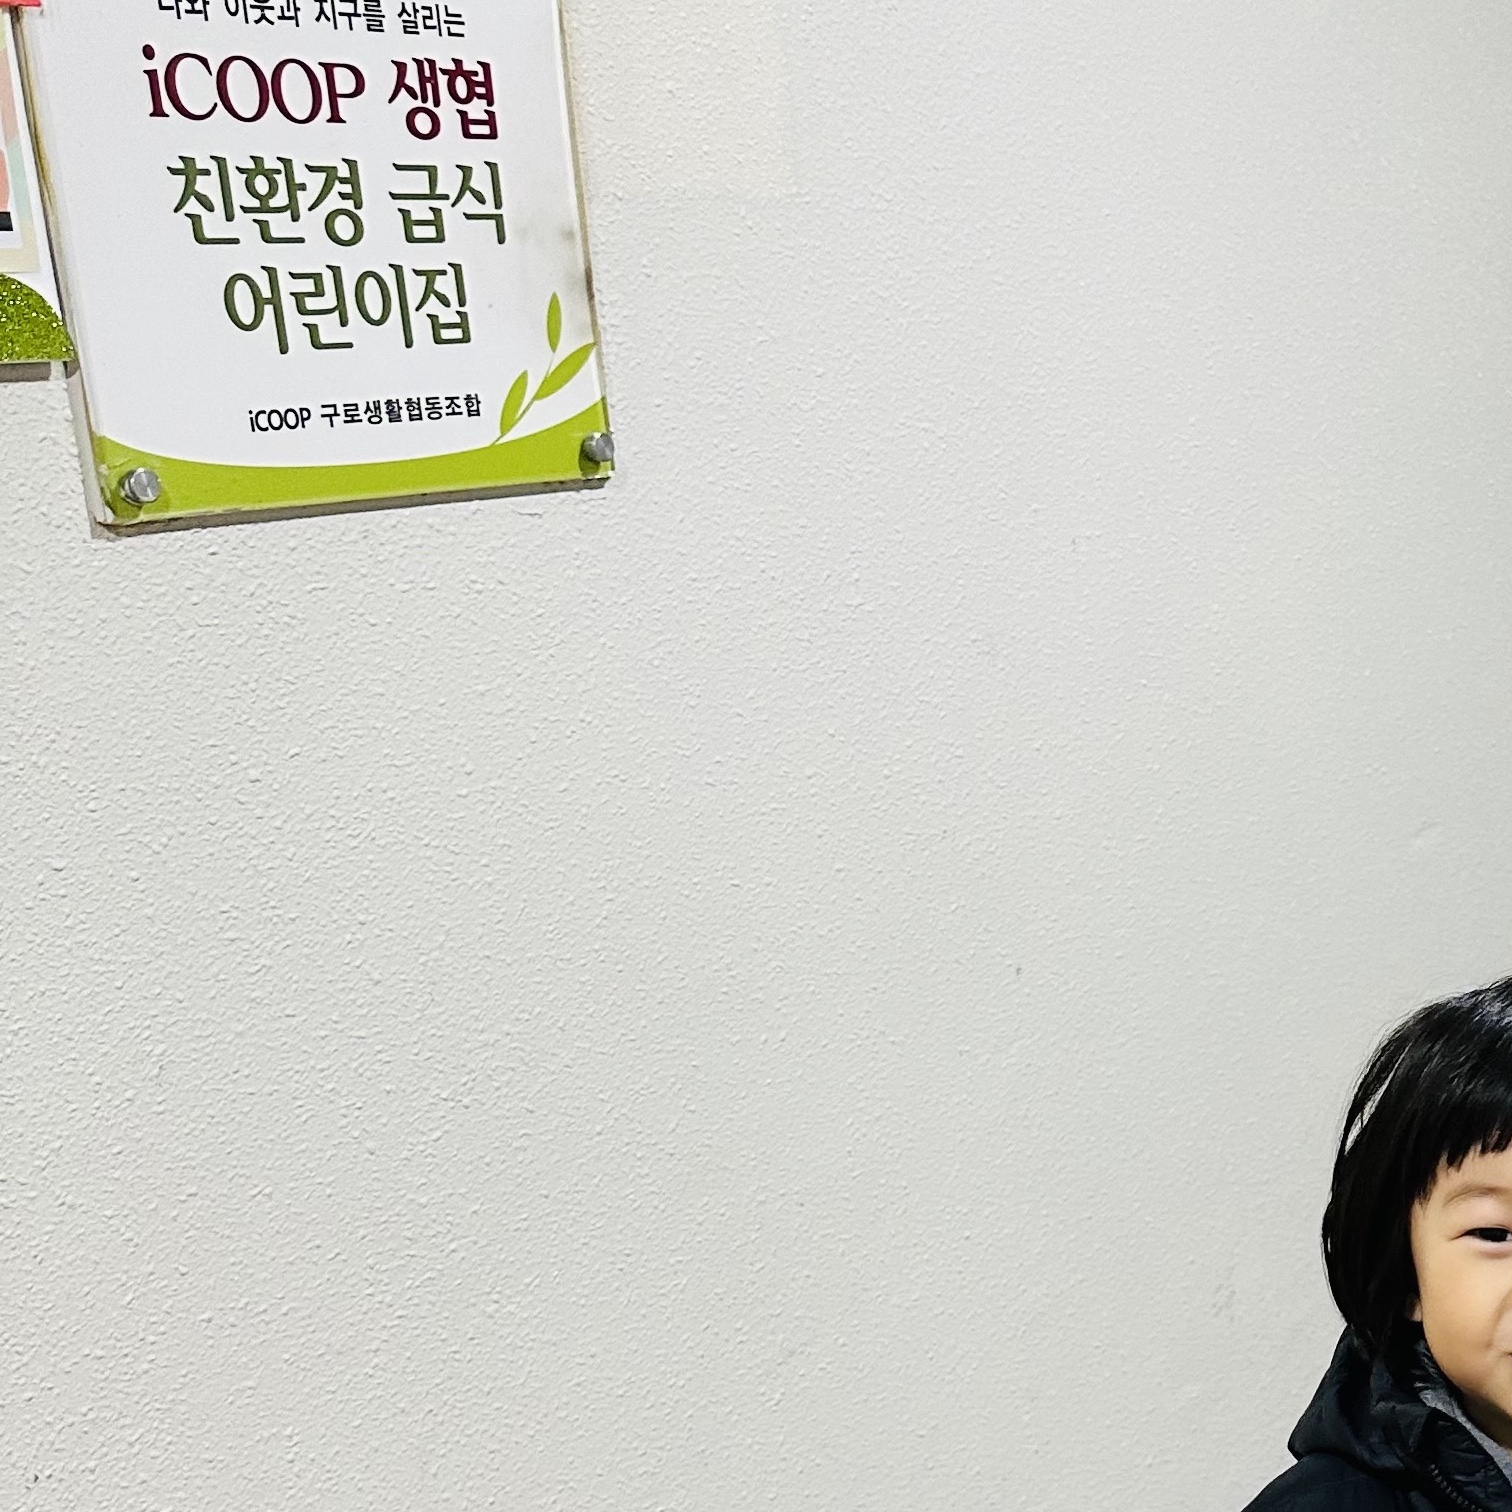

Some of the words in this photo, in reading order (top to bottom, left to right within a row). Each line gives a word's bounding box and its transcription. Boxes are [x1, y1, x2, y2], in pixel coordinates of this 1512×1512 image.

[314, 0, 385, 32] 지구를
[398, 2, 465, 37] 살리는
[142, 44, 365, 124] iCOOP
[388, 58, 498, 140] 생협
[167, 156, 363, 246] 친환경
[389, 161, 505, 244] 급식
[224, 263, 471, 354] 어린이집
[249, 408, 311, 432] iCOOP
[321, 394, 481, 427] 구로생활협동조합
